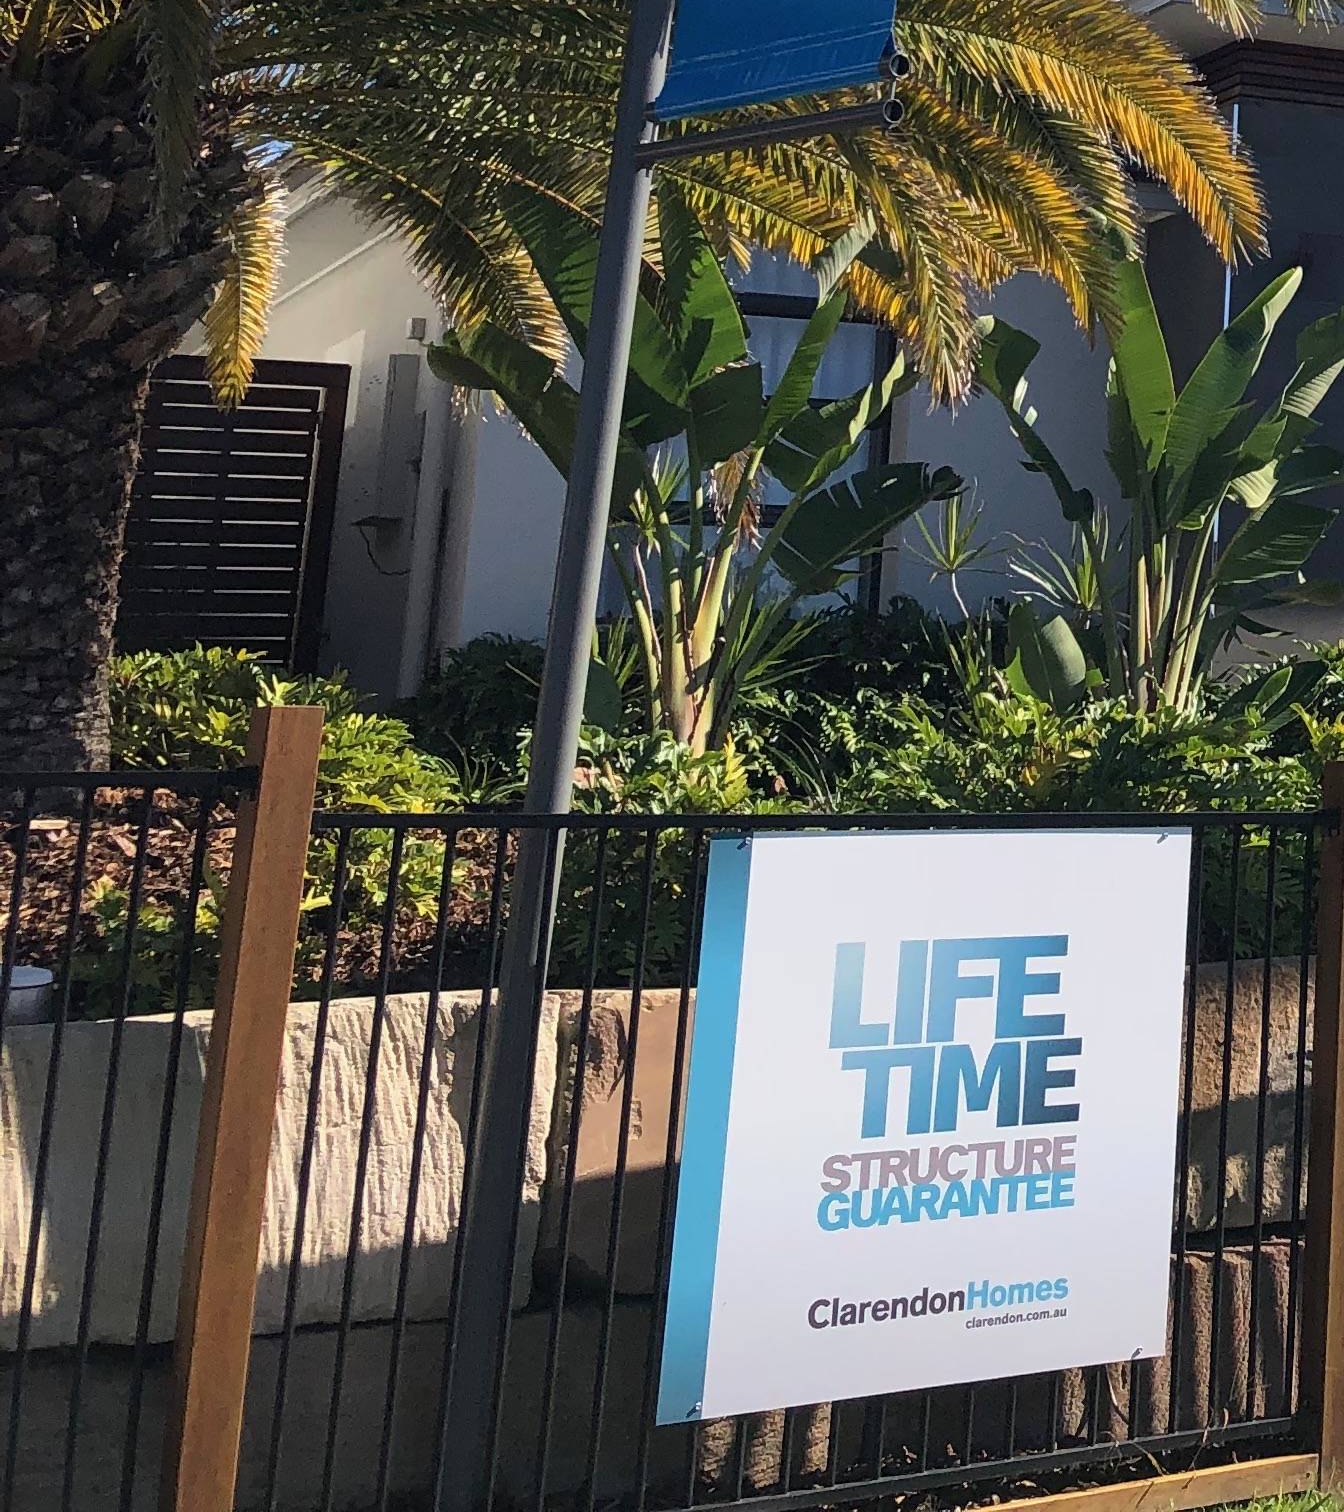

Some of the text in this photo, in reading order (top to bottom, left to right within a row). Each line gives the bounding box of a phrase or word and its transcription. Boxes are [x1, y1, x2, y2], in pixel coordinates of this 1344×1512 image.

[829, 934, 1069, 1049] LIFE
[841, 1037, 1083, 1139] TIME
[821, 1135, 1078, 1194] STRUCTURE
[817, 1171, 1076, 1232] GUARANTEE
[965, 1307, 1068, 1330] clarendon.com.au
